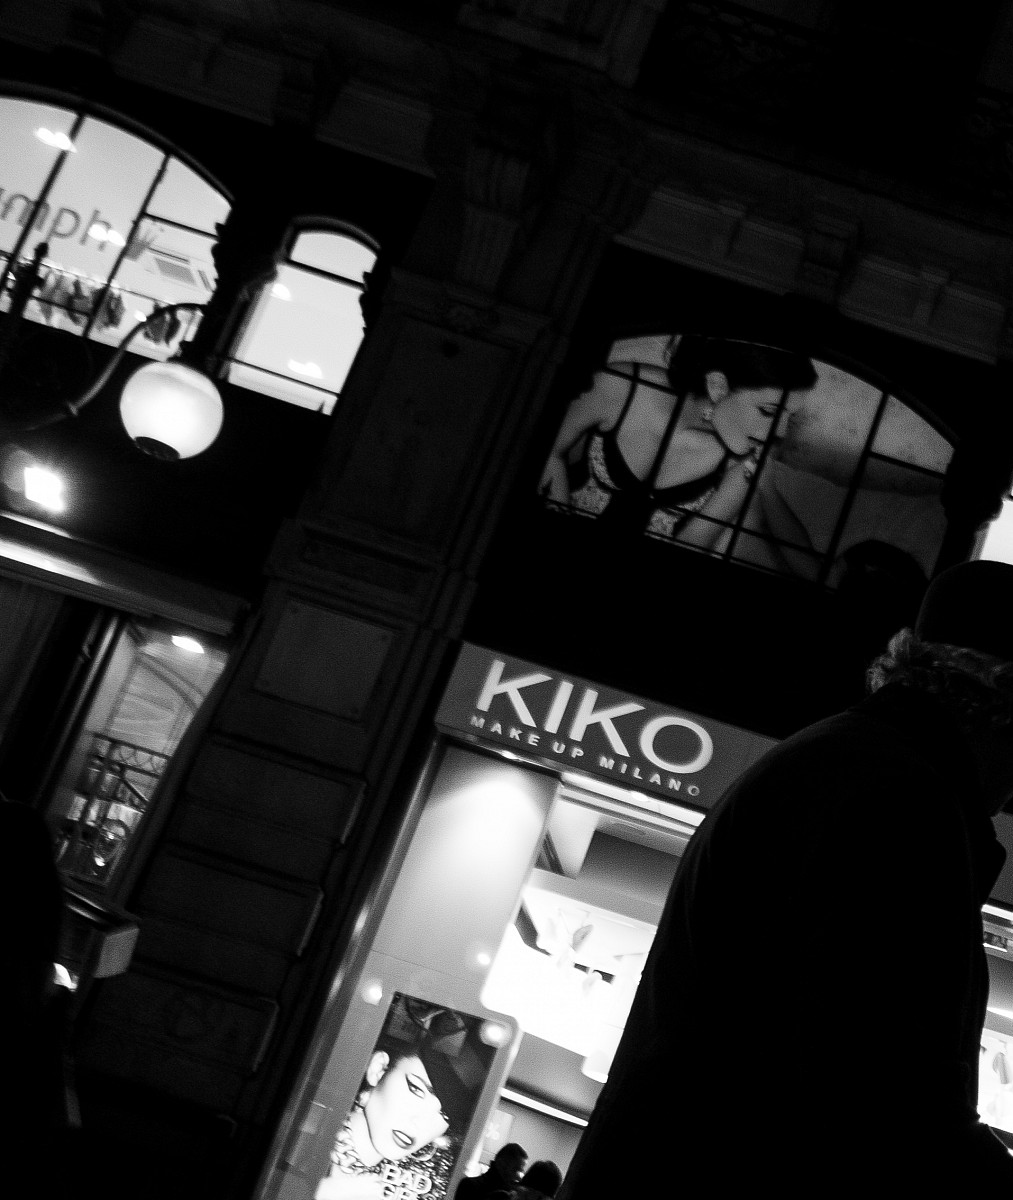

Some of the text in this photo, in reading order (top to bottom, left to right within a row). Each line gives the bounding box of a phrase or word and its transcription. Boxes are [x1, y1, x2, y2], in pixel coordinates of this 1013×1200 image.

[470, 715, 700, 797] MAKE UP MILANO
[475, 659, 714, 774] KIKO
[382, 1163, 433, 1195] BAD
